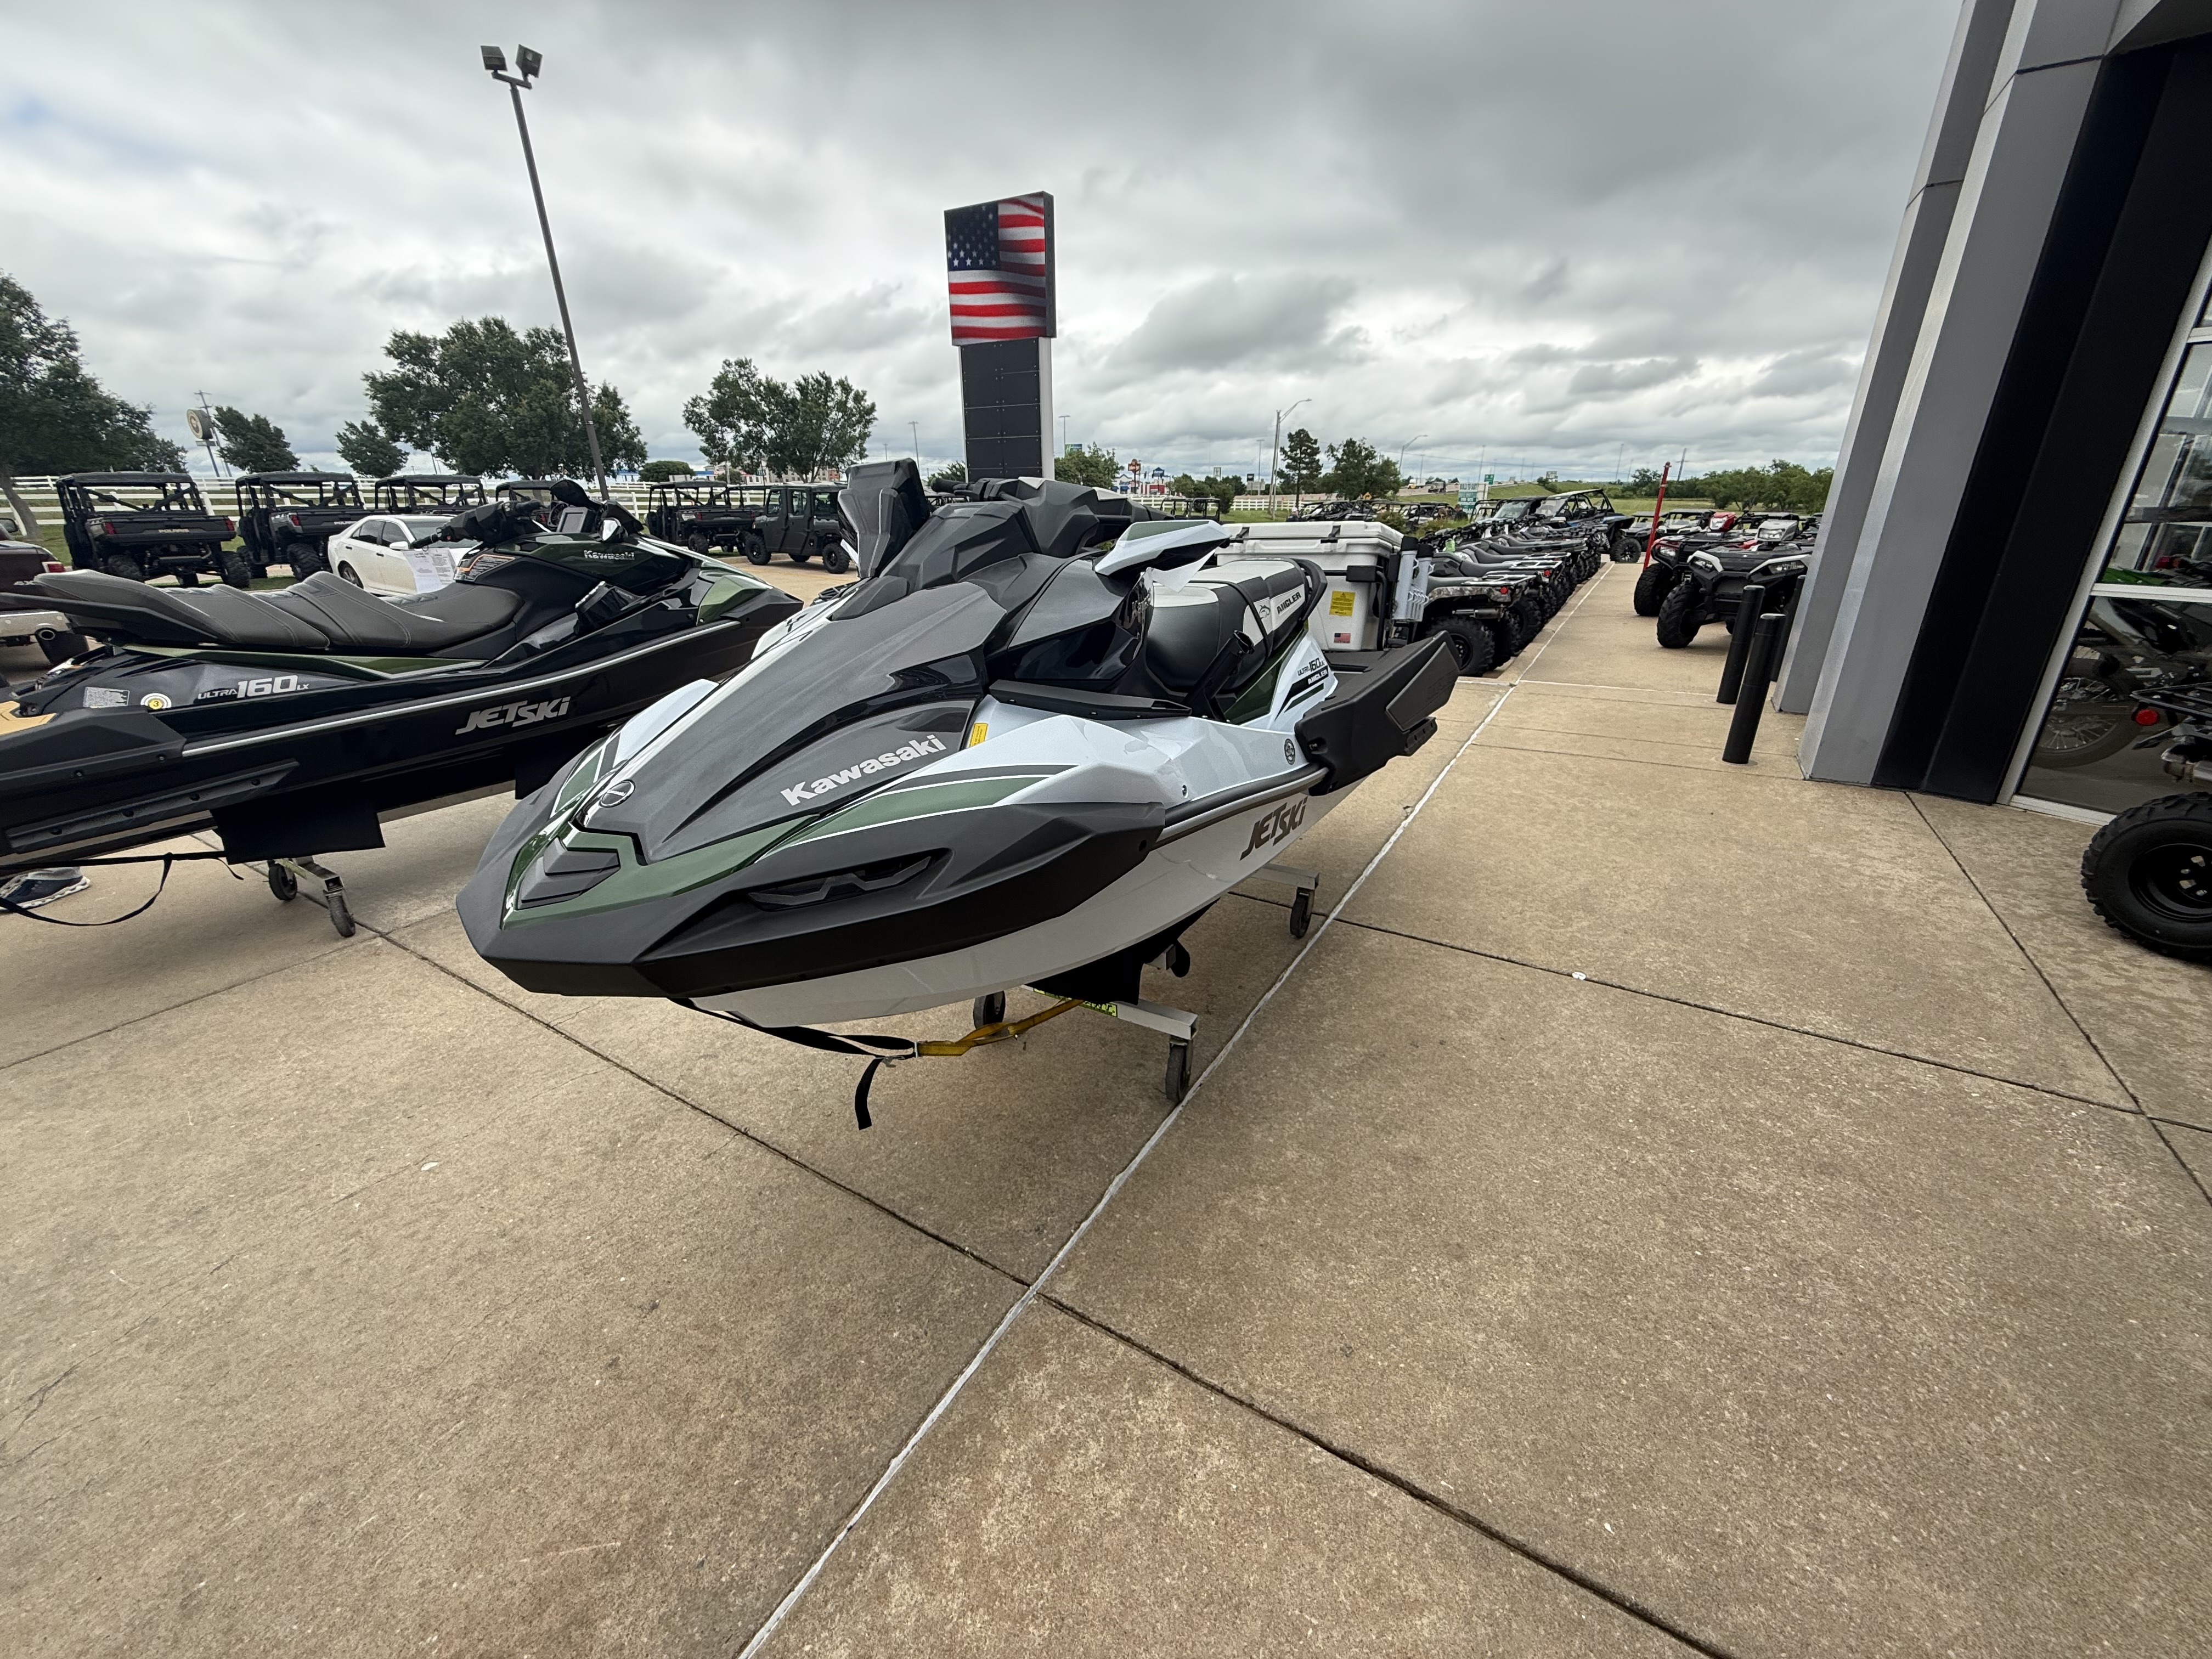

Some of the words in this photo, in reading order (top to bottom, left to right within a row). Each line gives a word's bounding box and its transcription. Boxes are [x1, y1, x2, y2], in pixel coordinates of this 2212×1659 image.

[584, 550, 635, 560] Kawasaki
[1277, 591, 1302, 614] ANGLER
[1308, 669, 1328, 685] ANGLER
[780, 734, 947, 806] Kawasaki
